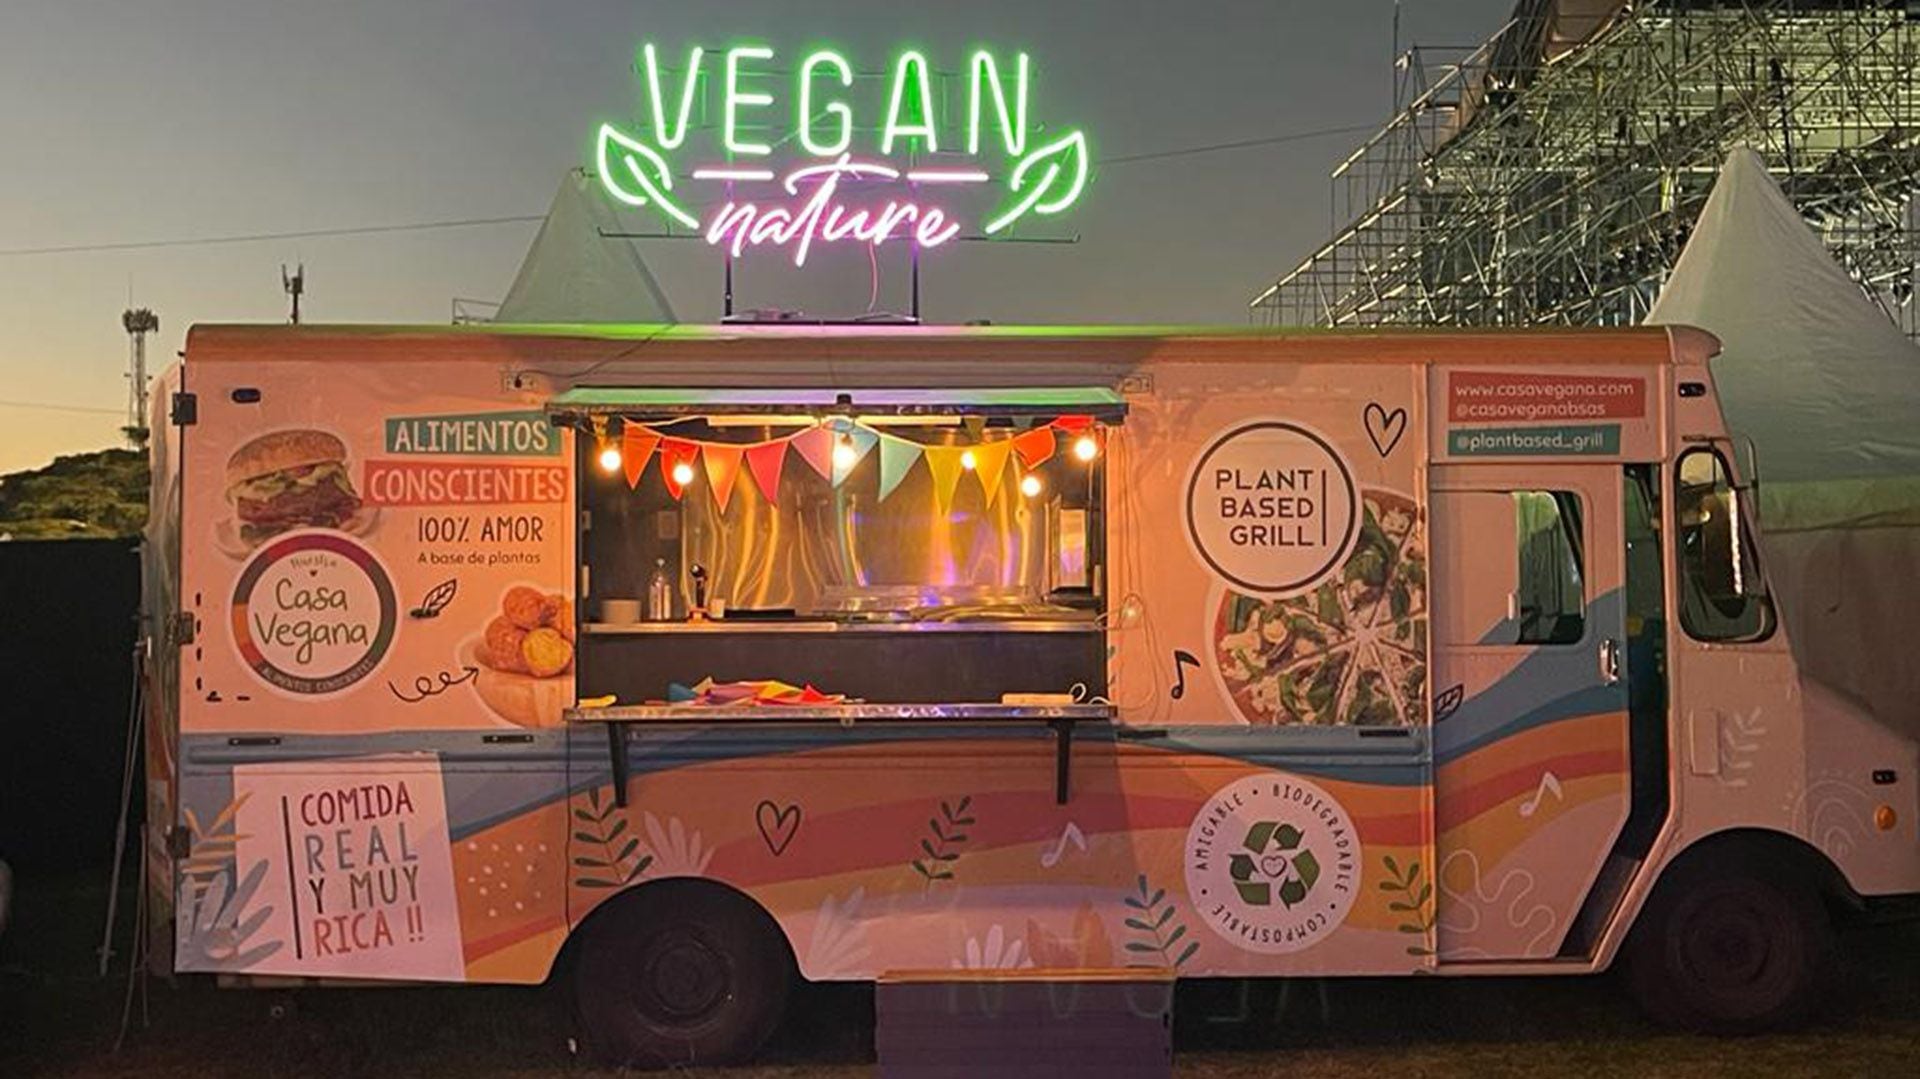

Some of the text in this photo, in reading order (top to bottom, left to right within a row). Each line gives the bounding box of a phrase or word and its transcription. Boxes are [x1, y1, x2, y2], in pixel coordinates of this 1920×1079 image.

[644, 42, 1029, 157] VEGAN
[706, 152, 960, 267] nature
[1455, 383, 1635, 400] www.casavegana.com
[1456, 402, 1606, 420] @casaveganabsas
[393, 419, 549, 453] ALIMENTOS
[1457, 432, 1604, 451] @plantbased_grill
[369, 467, 565, 502] CONSCIENTES
[1215, 469, 1314, 491] PLANT
[1220, 496, 1314, 519] BASED
[418, 516, 544, 543] 100% AMOR
[1229, 524, 1315, 547] GRILL
[418, 551, 541, 567] A base de plantas
[275, 577, 348, 612] Casa
[254, 612, 368, 665] Vegana
[301, 781, 414, 827] COMIDA
[304, 821, 419, 875] REAL
[1195, 783, 1352, 943] AMIGABLE BIODEGRADABLE COMPOSTABLE
[308, 865, 419, 914] Y MUY
[313, 909, 394, 958] RICA
